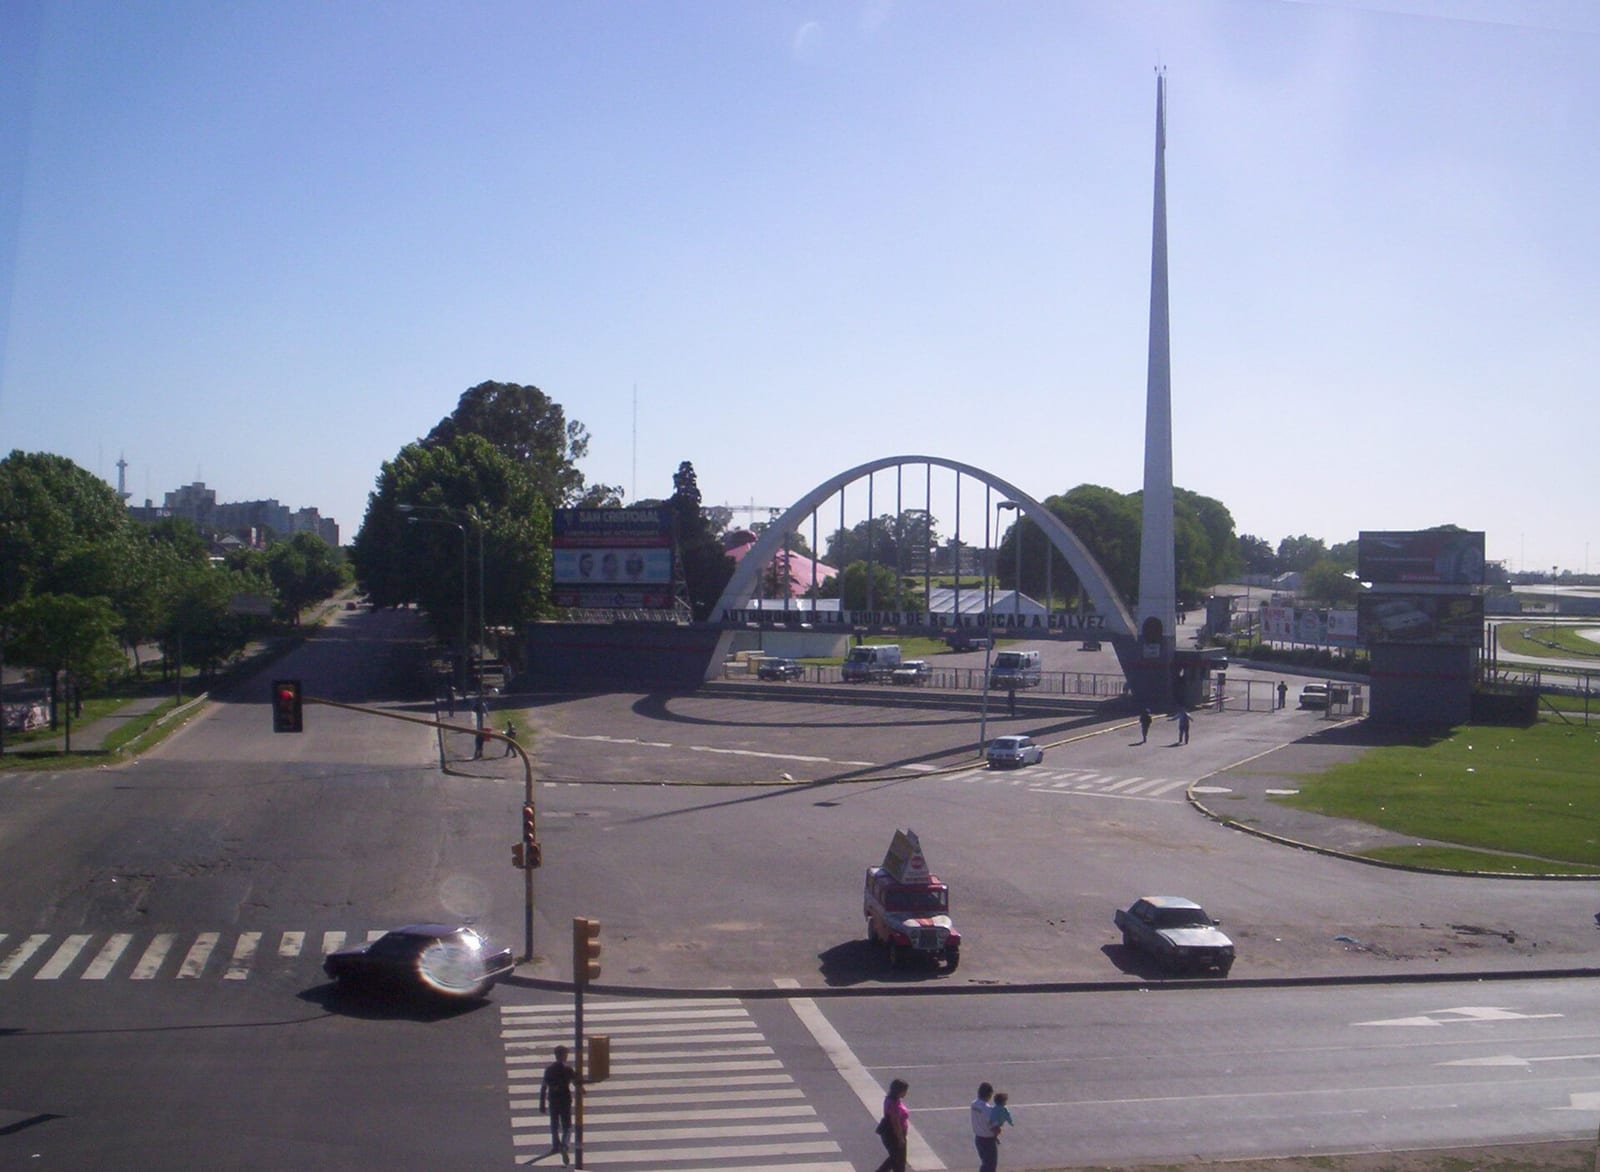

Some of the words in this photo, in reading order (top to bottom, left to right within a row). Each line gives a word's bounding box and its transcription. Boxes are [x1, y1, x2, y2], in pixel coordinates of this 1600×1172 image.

[806, 610, 823, 624] DE
[828, 611, 845, 624] LA
[850, 611, 900, 625] CIUDAD
[907, 612, 924, 626] DE
[1032, 613, 1043, 628] A
[1048, 613, 1106, 630] GALVEZ
